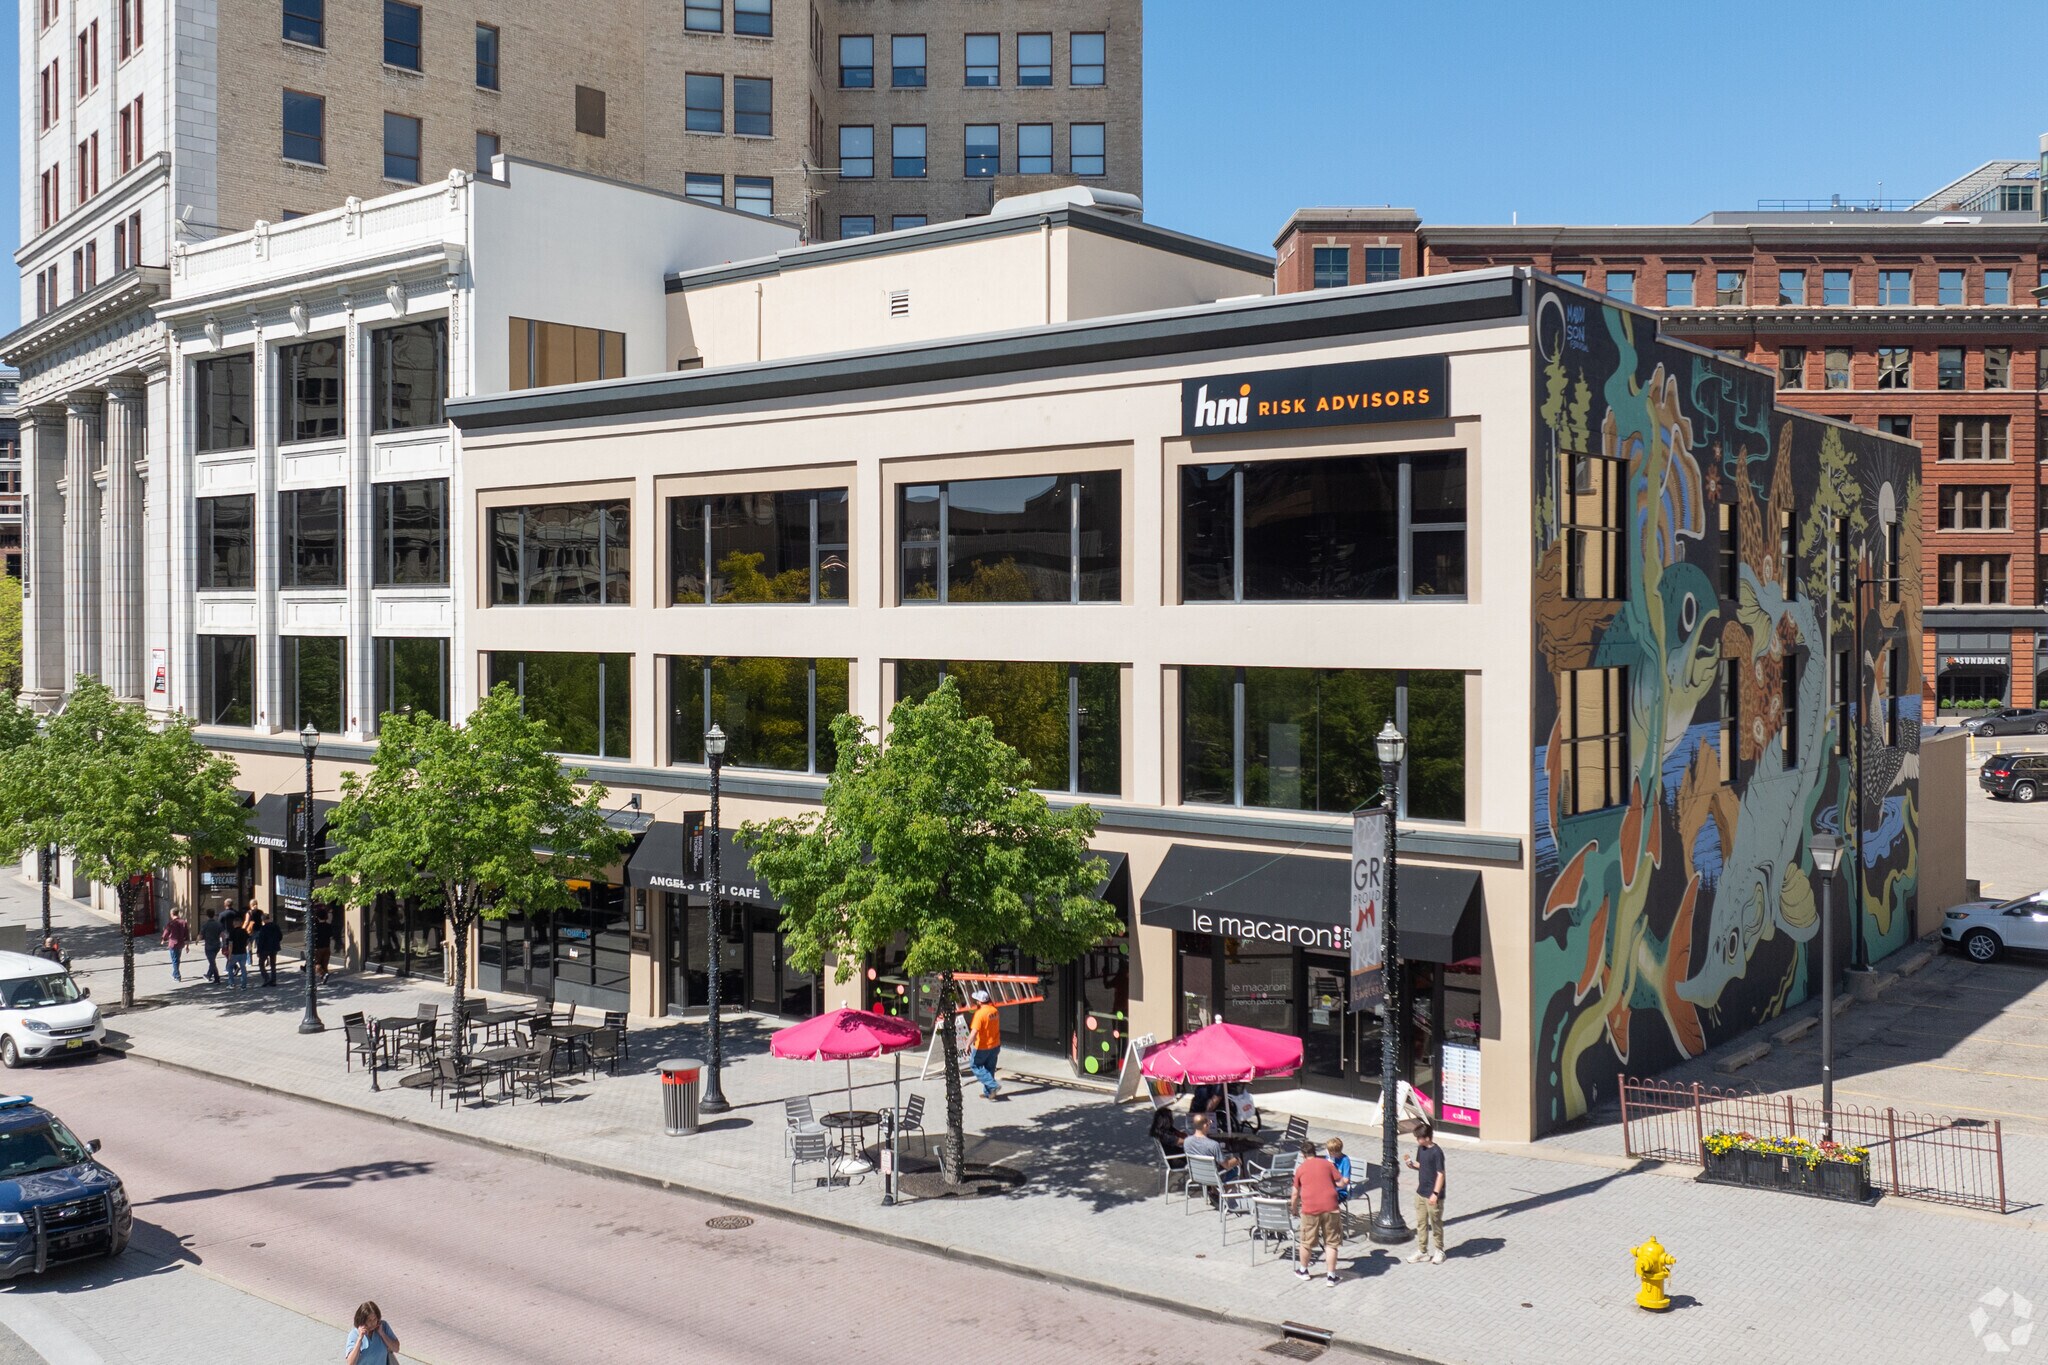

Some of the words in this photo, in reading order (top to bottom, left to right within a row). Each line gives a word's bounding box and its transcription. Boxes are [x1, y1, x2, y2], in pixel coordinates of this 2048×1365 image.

[1194, 383, 1251, 428] hni
[1258, 398, 1306, 416] RISK
[1316, 388, 1430, 413] ADVISORS
[1960, 656, 2006, 665] SUNDANCE
[1354, 857, 1380, 891] GR
[730, 887, 761, 899] CAFÉ
[1192, 909, 1213, 933] le
[1219, 917, 1332, 948] macaron
[1242, 984, 1287, 992] macaron
